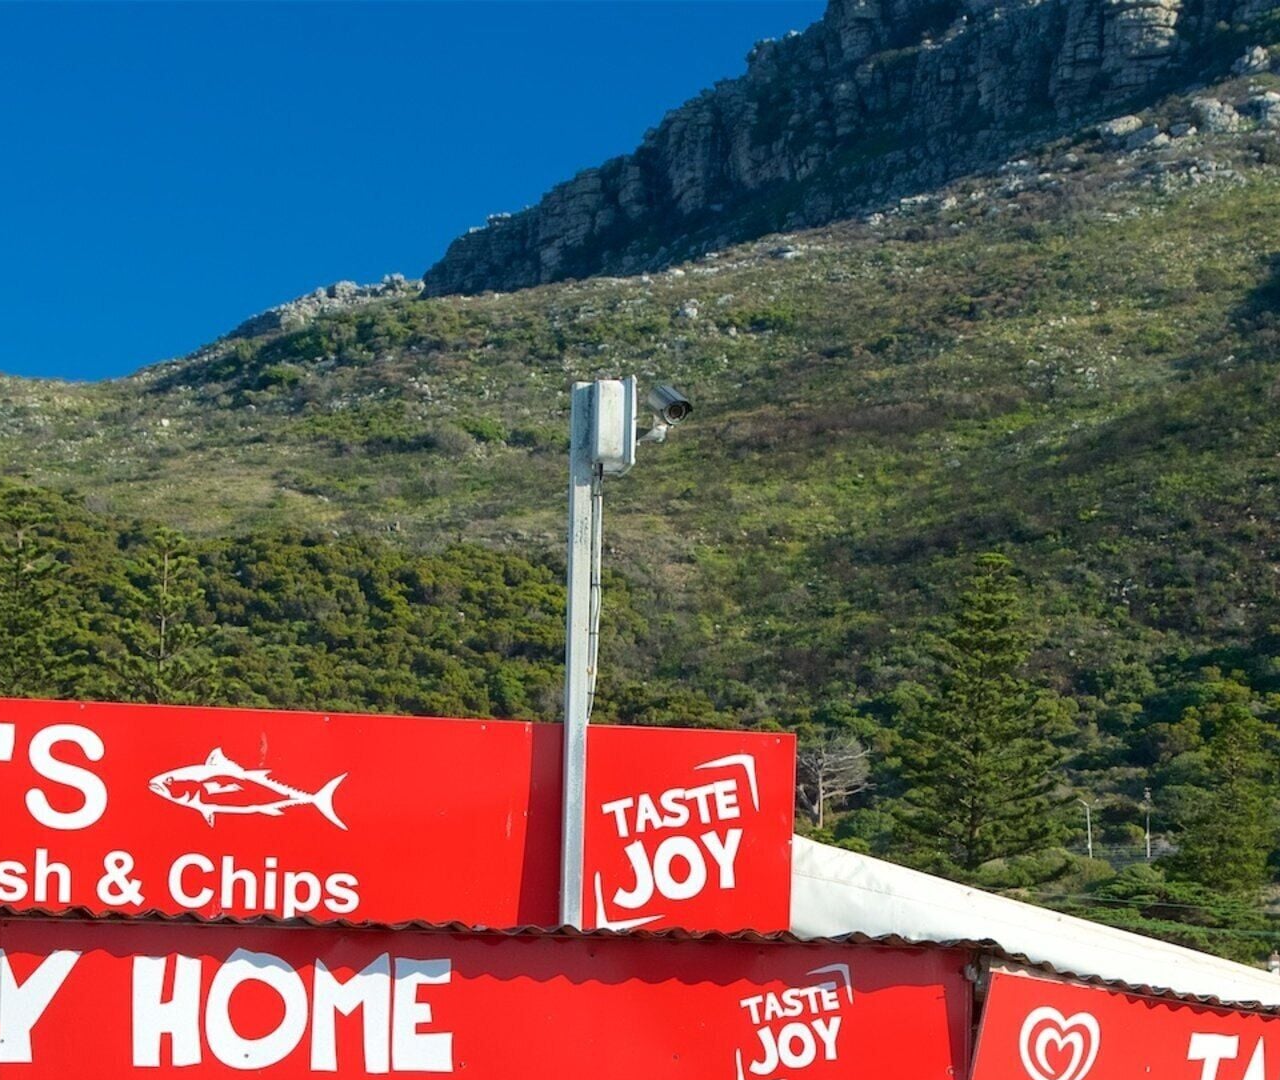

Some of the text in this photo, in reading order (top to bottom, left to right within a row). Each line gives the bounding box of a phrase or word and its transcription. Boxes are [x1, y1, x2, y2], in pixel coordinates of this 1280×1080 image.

[602, 779, 741, 838] TASTE
[97, 851, 146, 907] &
[169, 854, 360, 920] Chips
[613, 829, 743, 911] JOY
[132, 948, 454, 1075] HOME
[740, 982, 841, 1025] TASTE
[749, 1016, 842, 1076] JOY
